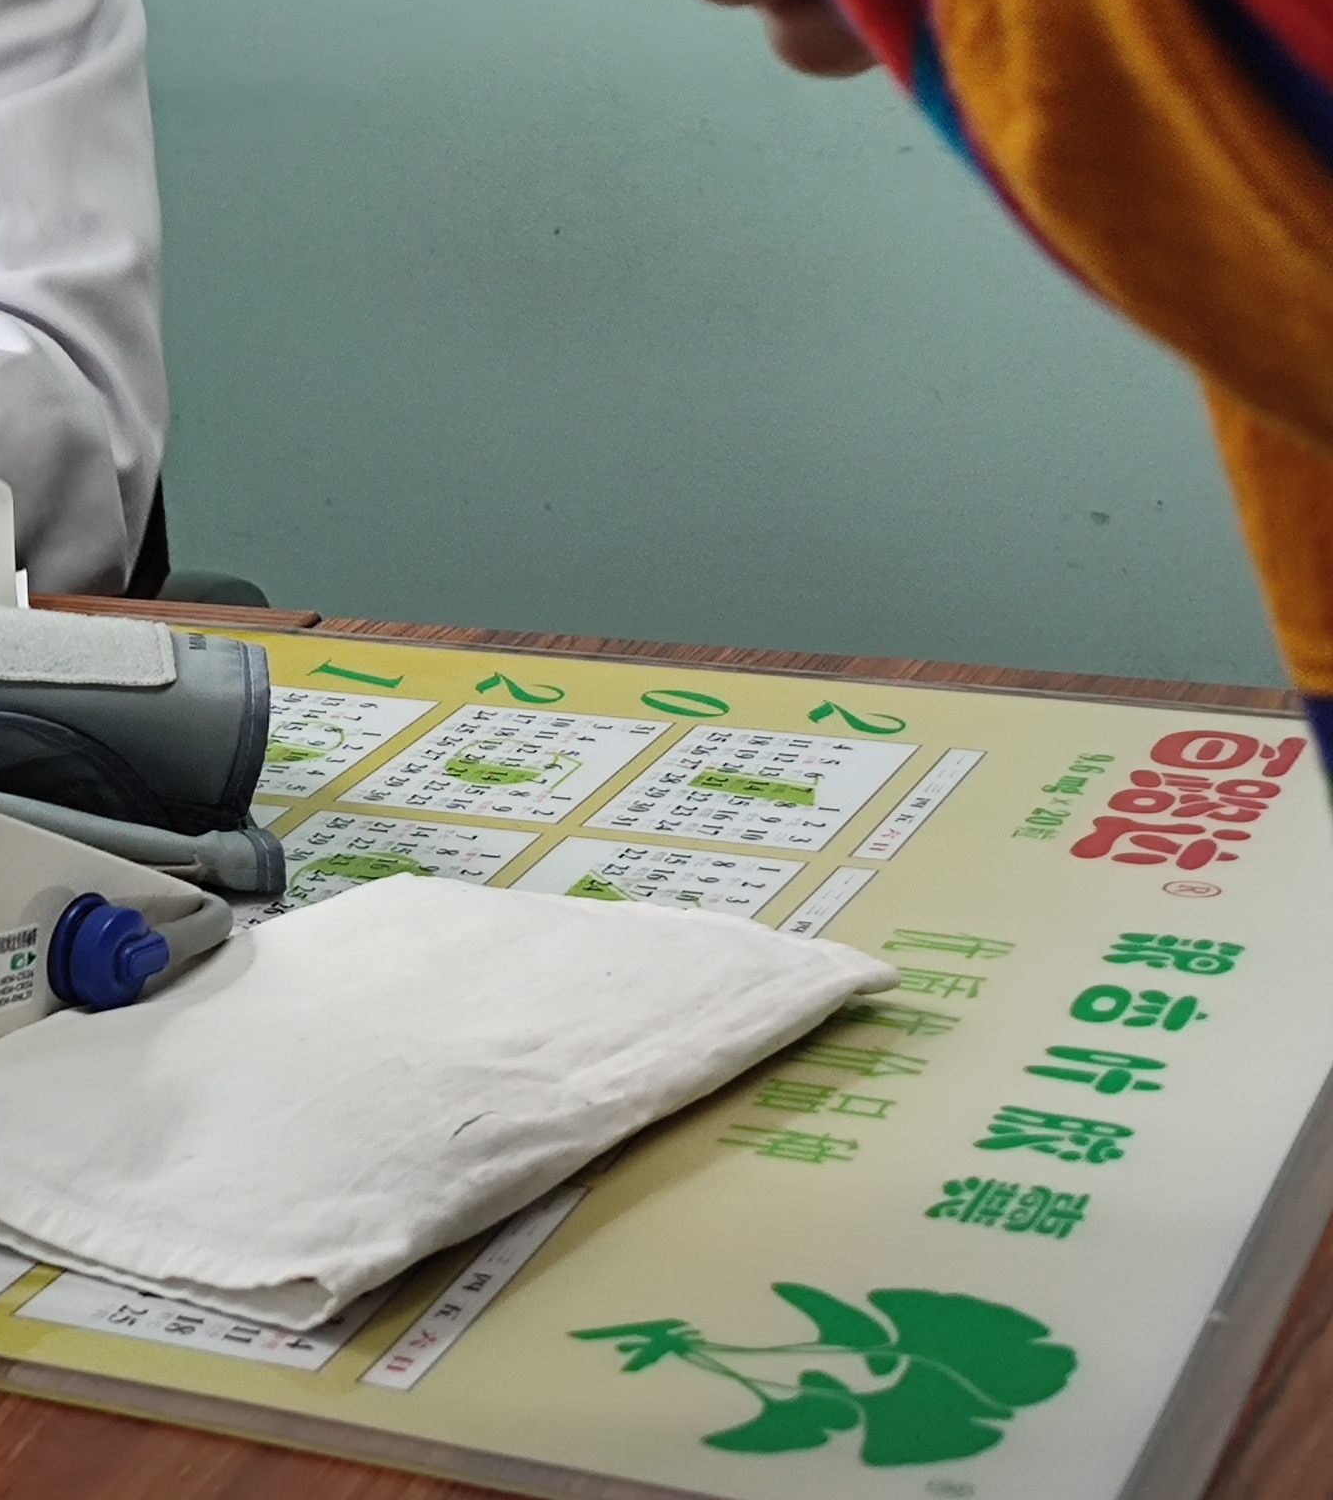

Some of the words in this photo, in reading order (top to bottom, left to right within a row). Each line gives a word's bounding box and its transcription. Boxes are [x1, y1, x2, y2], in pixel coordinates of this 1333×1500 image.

[1041, 775, 1088, 795] mg
[1068, 753, 1115, 773] 9.6
[1070, 729, 1308, 870] 百路达
[925, 931, 1246, 1239] 银杏叶胶囊
